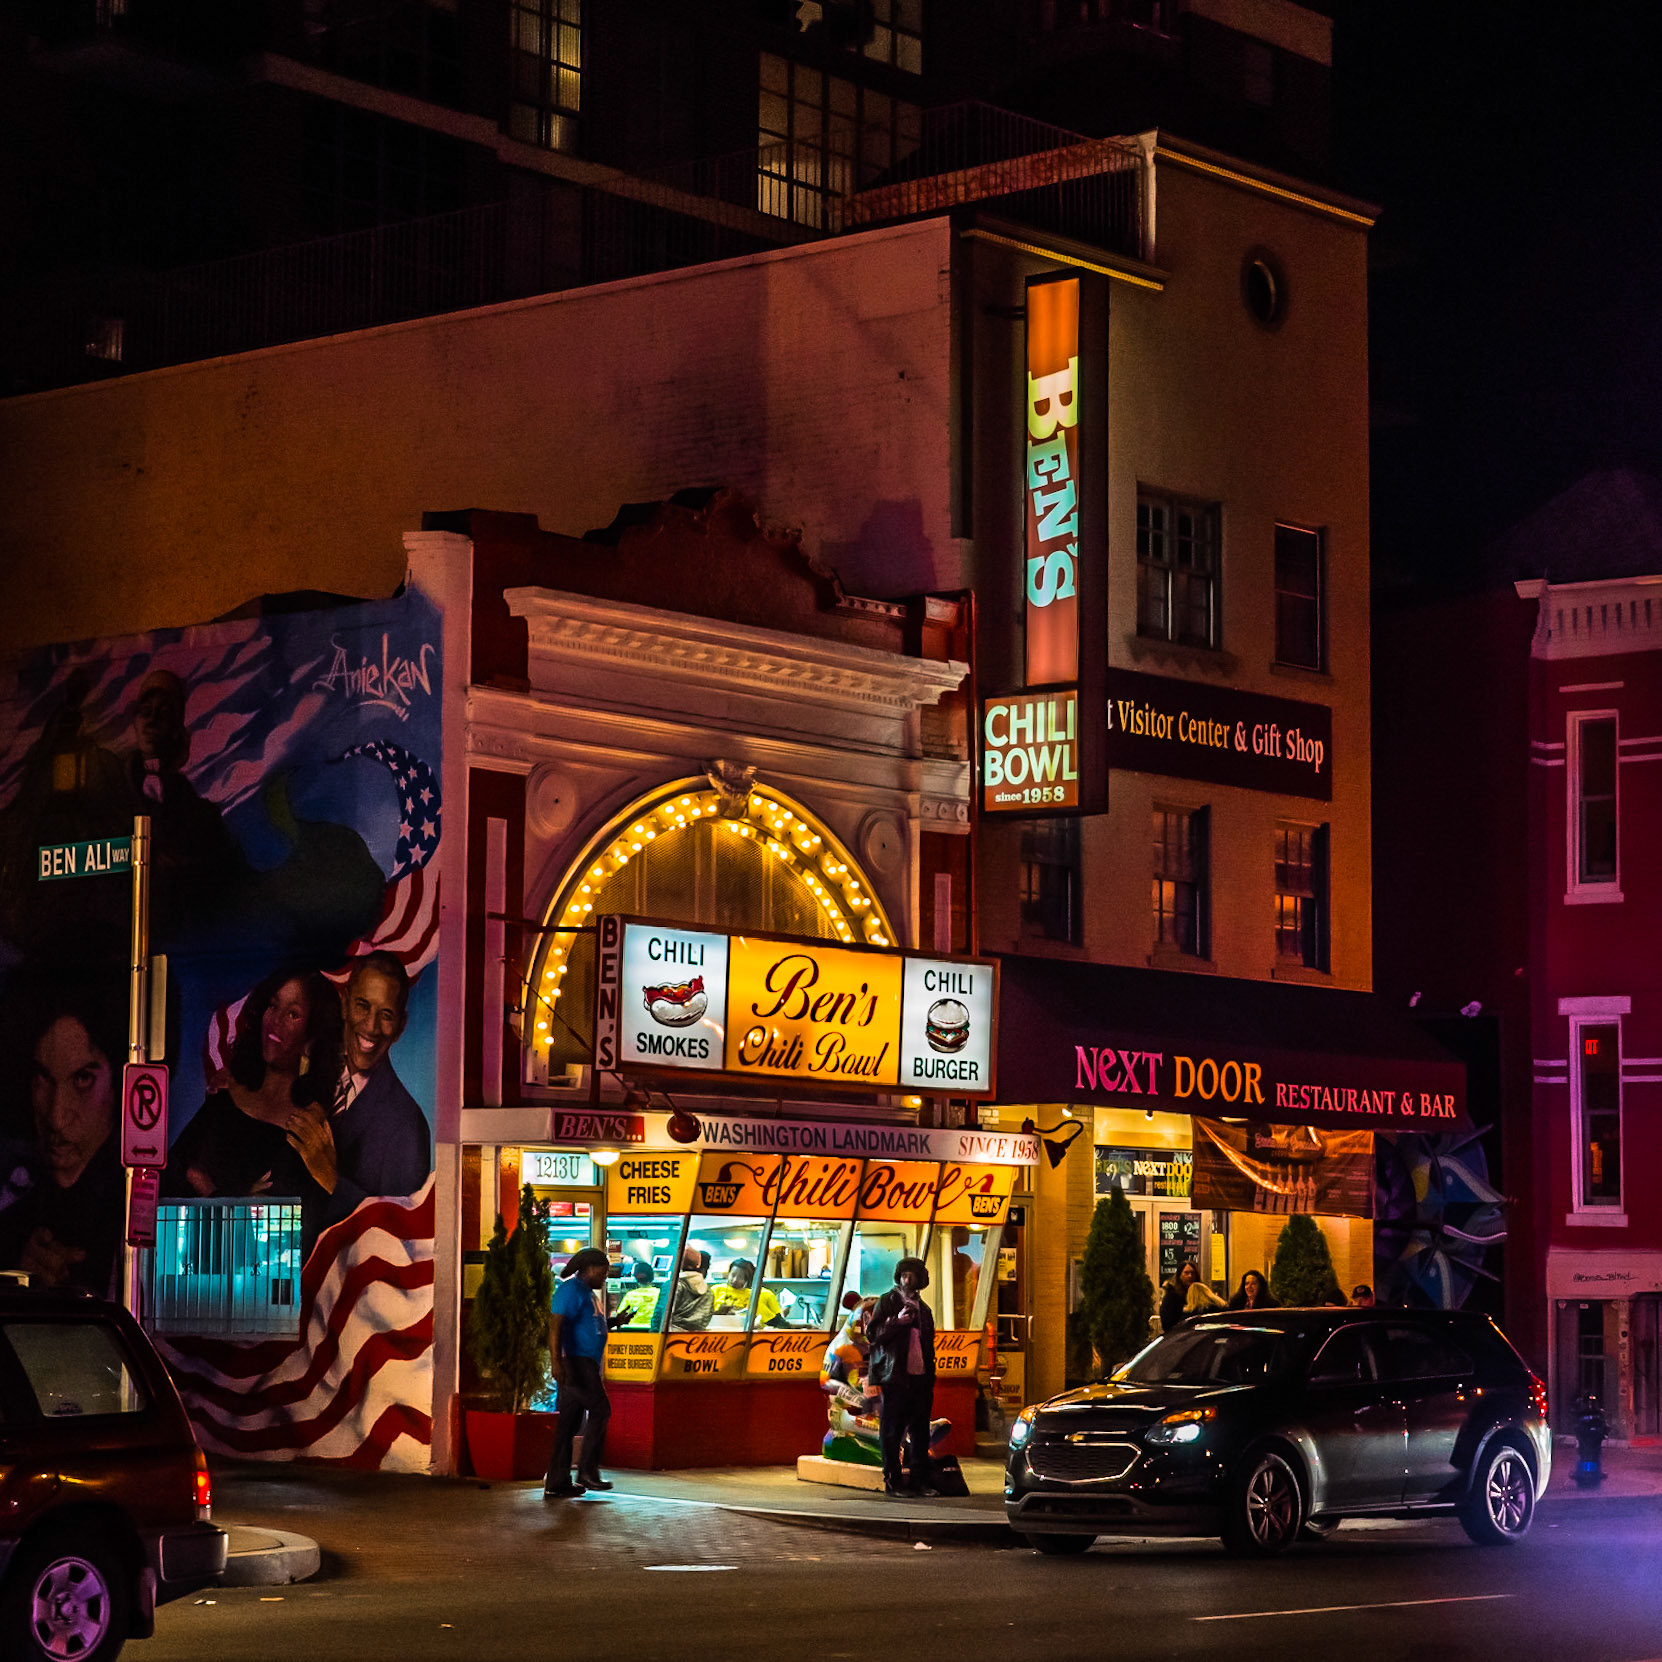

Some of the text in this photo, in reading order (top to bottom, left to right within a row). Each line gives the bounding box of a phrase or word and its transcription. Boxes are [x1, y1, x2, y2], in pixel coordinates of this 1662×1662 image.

[1027, 355, 1080, 607] BEN'S
[984, 699, 1076, 748] CHILI
[1117, 699, 1175, 742] Visitor
[1178, 710, 1232, 750] Center
[1234, 725, 1249, 753] &
[1252, 723, 1282, 758] Gift
[1286, 728, 1325, 773] Shop
[984, 743, 1078, 787] BOWL
[995, 786, 1065, 804] since 1958
[41, 842, 130, 877] BEN ALI WAY
[648, 937, 705, 966] CHILI
[598, 917, 618, 1068] BEN'S
[751, 954, 878, 1027] Ben's
[924, 969, 973, 995] CHILI
[636, 1032, 709, 1059] SMOKES
[738, 1025, 890, 1077] Chili Bowl
[913, 1057, 979, 1081] BURGER
[1173, 1056, 1265, 1105] DOOR
[1275, 1082, 1396, 1116] RESTAURANT
[1400, 1093, 1415, 1115] &
[1420, 1093, 1457, 1119] BAR
[702, 1121, 931, 1154] WASHINGTON LANDMARK
[958, 1135, 1040, 1161] SINCE 1958
[619, 1160, 680, 1180] CHEESE
[1166, 1162, 1192, 1177] DOO
[628, 1186, 671, 1204] FRIES
[757, 1160, 961, 1211] Chili Bowl
[685, 1335, 730, 1354] Chili
[769, 1335, 814, 1353] Chili
[684, 1358, 719, 1373] BOWL
[768, 1358, 803, 1371] DOGS
